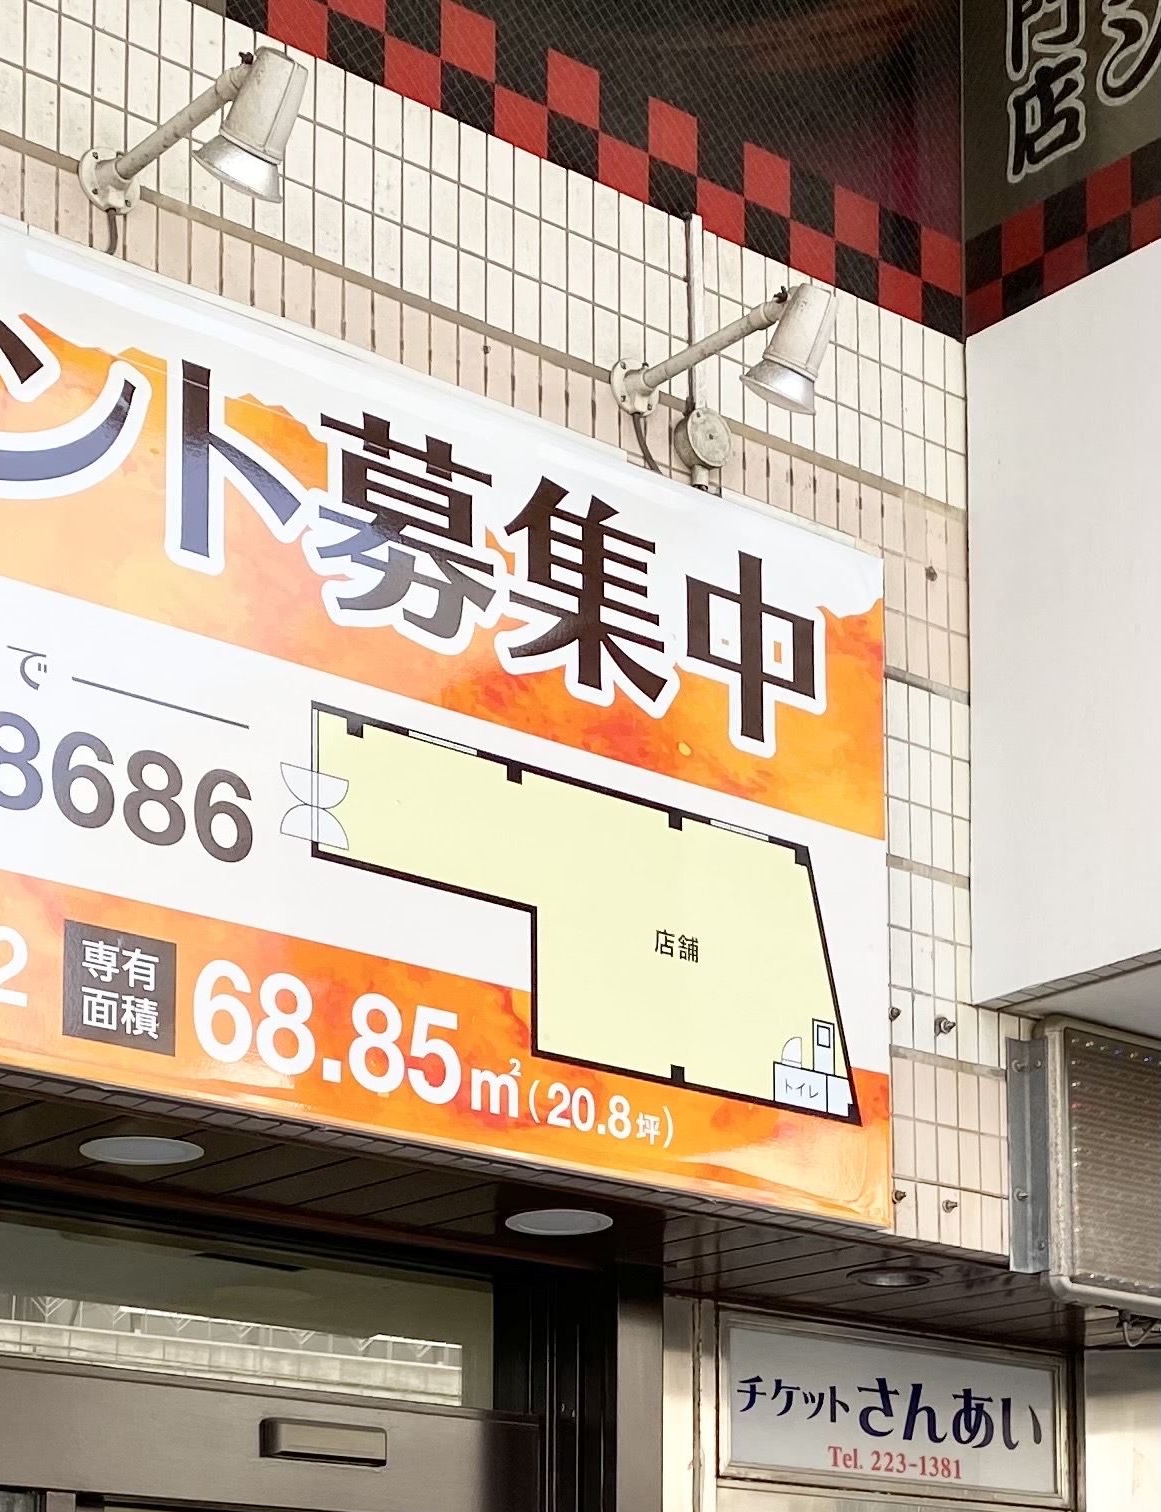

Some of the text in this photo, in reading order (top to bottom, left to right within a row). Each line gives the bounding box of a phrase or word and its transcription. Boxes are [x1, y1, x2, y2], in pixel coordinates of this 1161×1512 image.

[654, 928, 701, 964] 店舗
[80, 938, 160, 993] 専有
[80, 987, 160, 1042] 面積
[784, 1078, 820, 1099] トイレ
[827, 1446, 962, 1480] Tel. 223-1381
